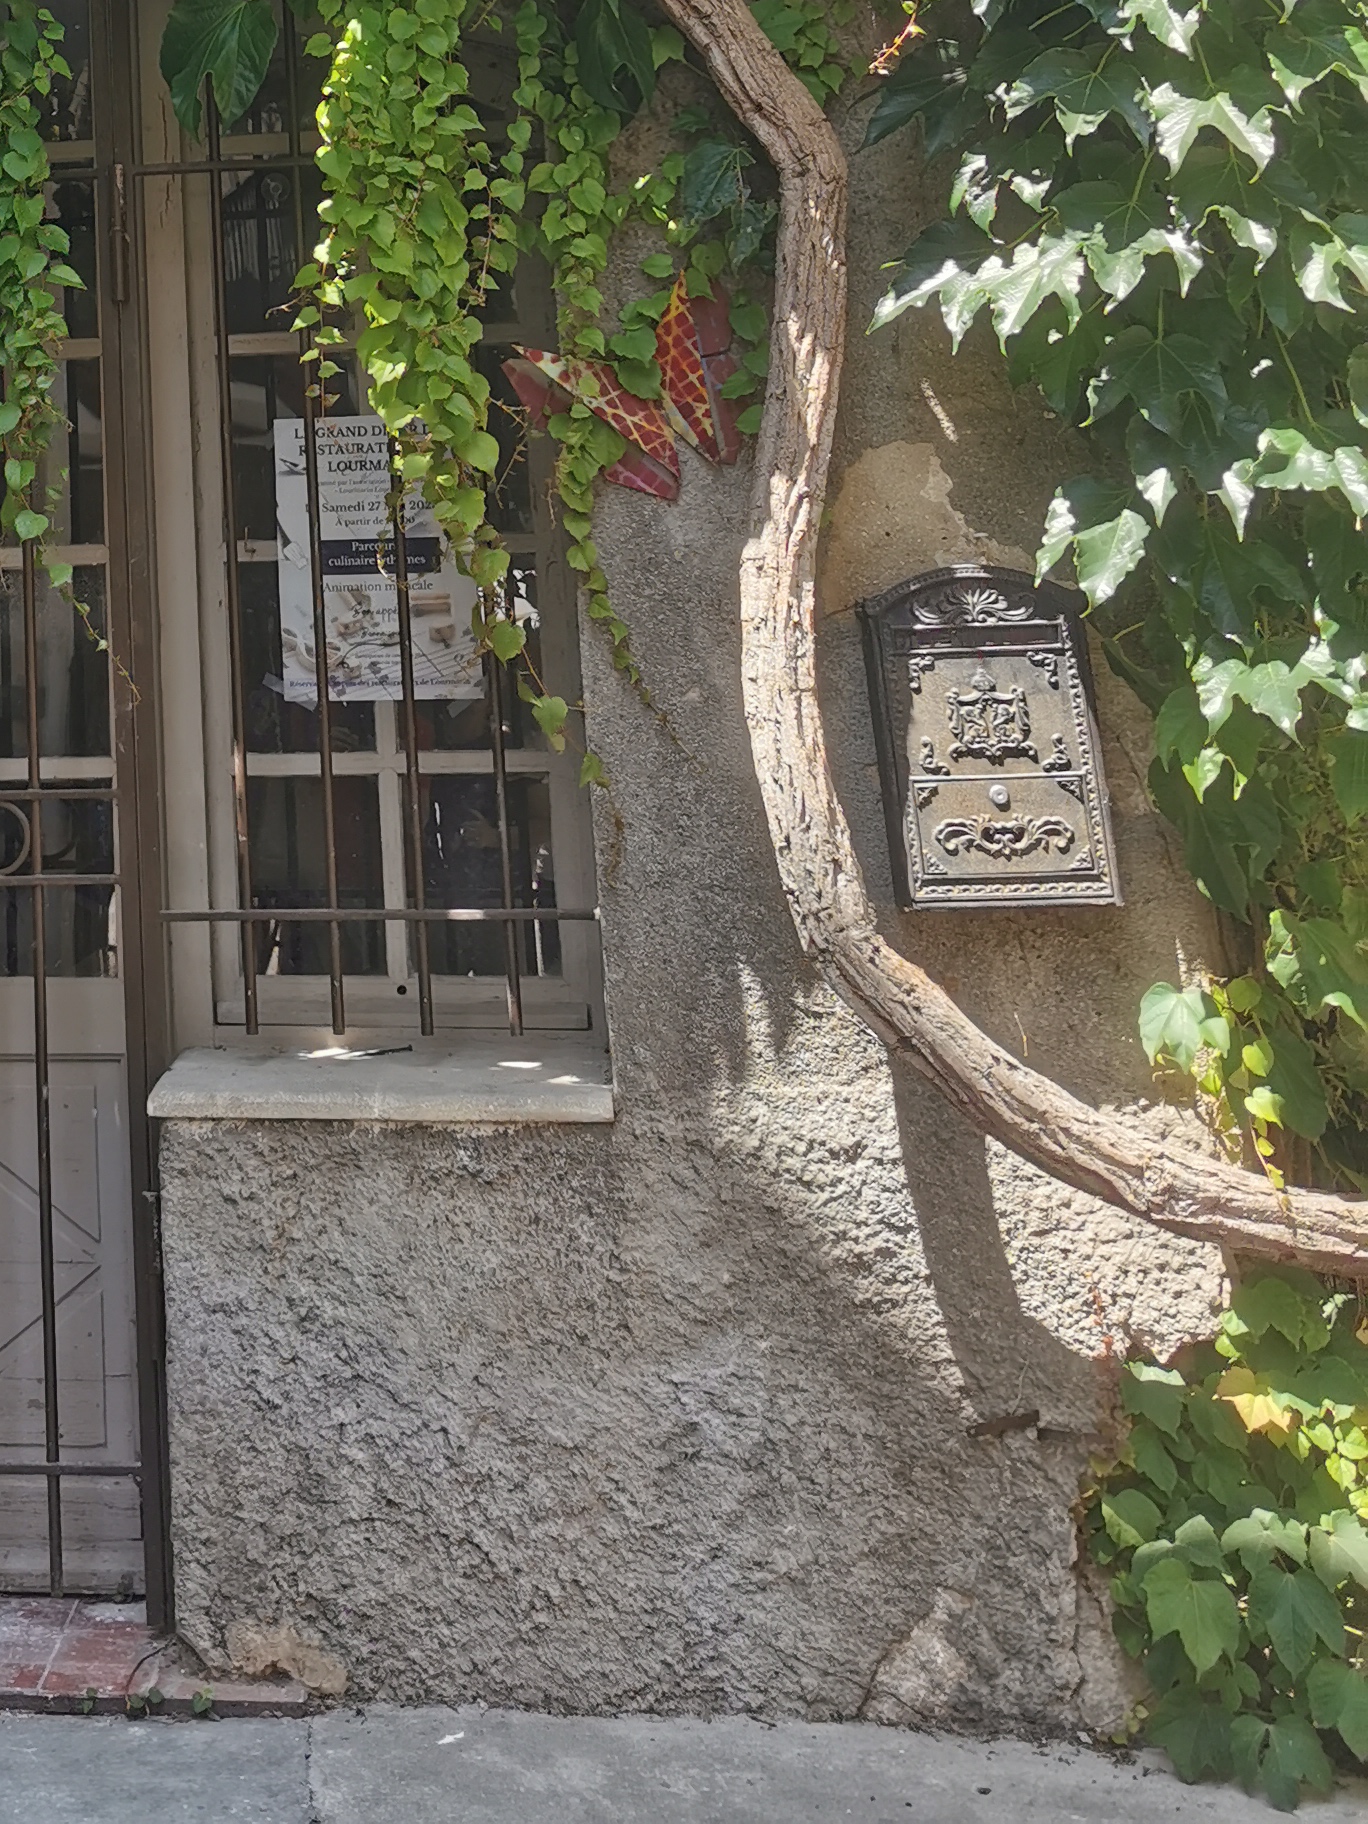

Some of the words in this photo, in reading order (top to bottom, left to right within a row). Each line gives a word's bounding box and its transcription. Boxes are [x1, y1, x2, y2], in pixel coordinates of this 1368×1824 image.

[315, 425, 368, 439] GRAND
[321, 500, 365, 513] Samedi
[367, 501, 381, 512] 27
[408, 499, 436, 511] 202
[344, 516, 370, 528] partir
[373, 516, 384, 526] de
[323, 582, 382, 593] Animation
